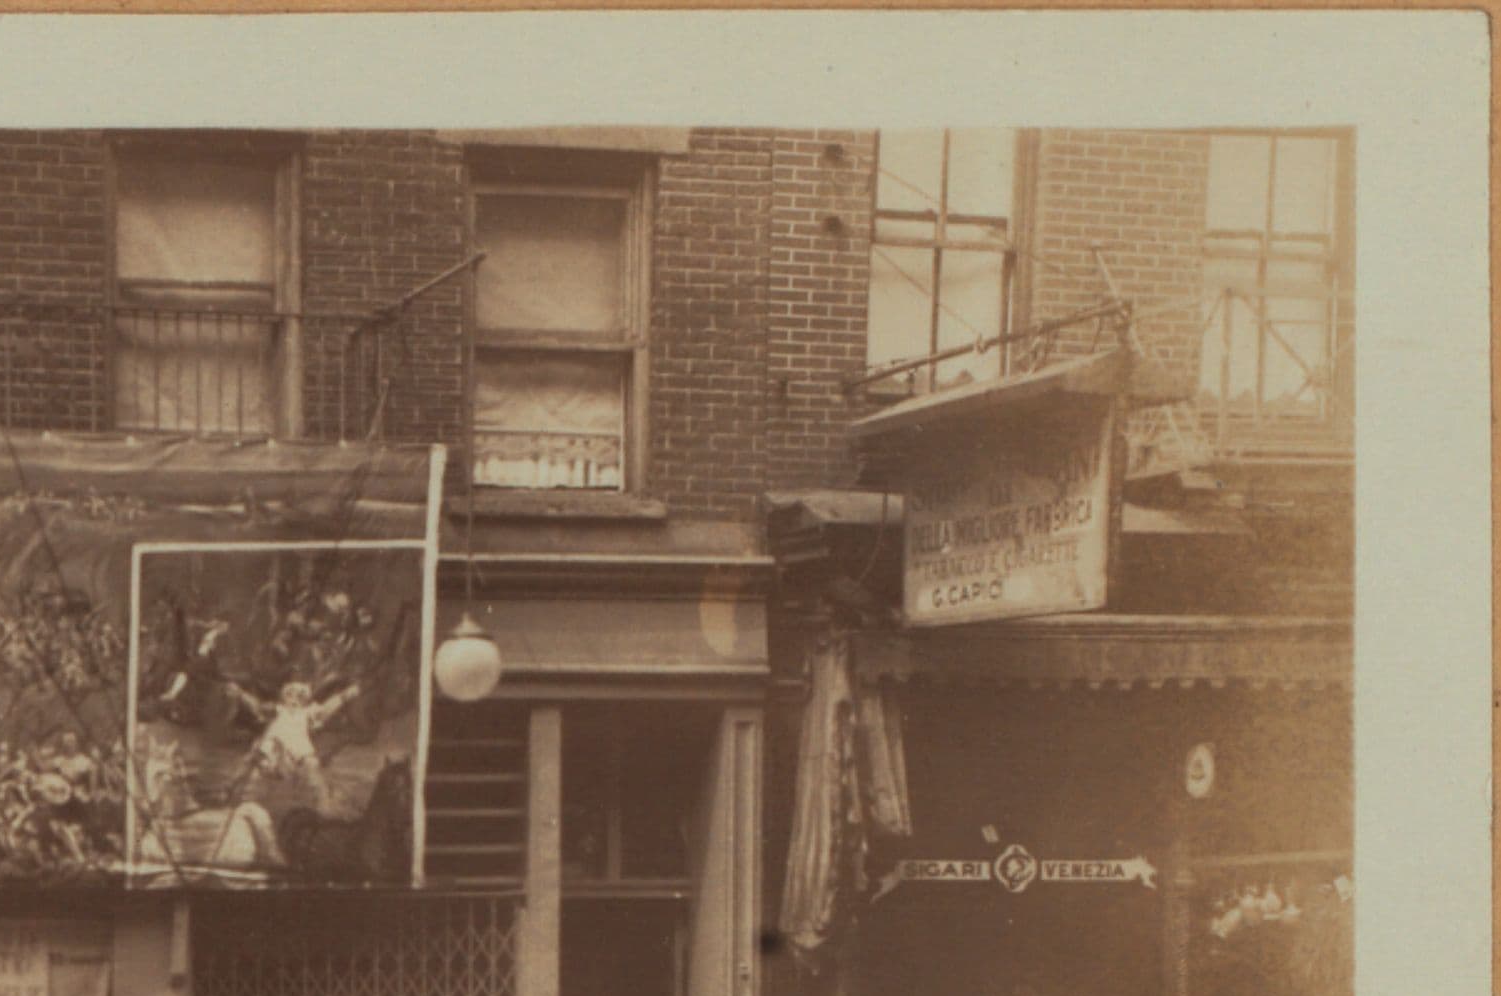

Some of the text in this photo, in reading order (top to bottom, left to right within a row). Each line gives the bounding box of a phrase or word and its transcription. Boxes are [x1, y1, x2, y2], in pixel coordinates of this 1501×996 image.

[1026, 494, 1093, 535] FABBRICA
[904, 862, 1126, 878] SIGARI VENEZIA
